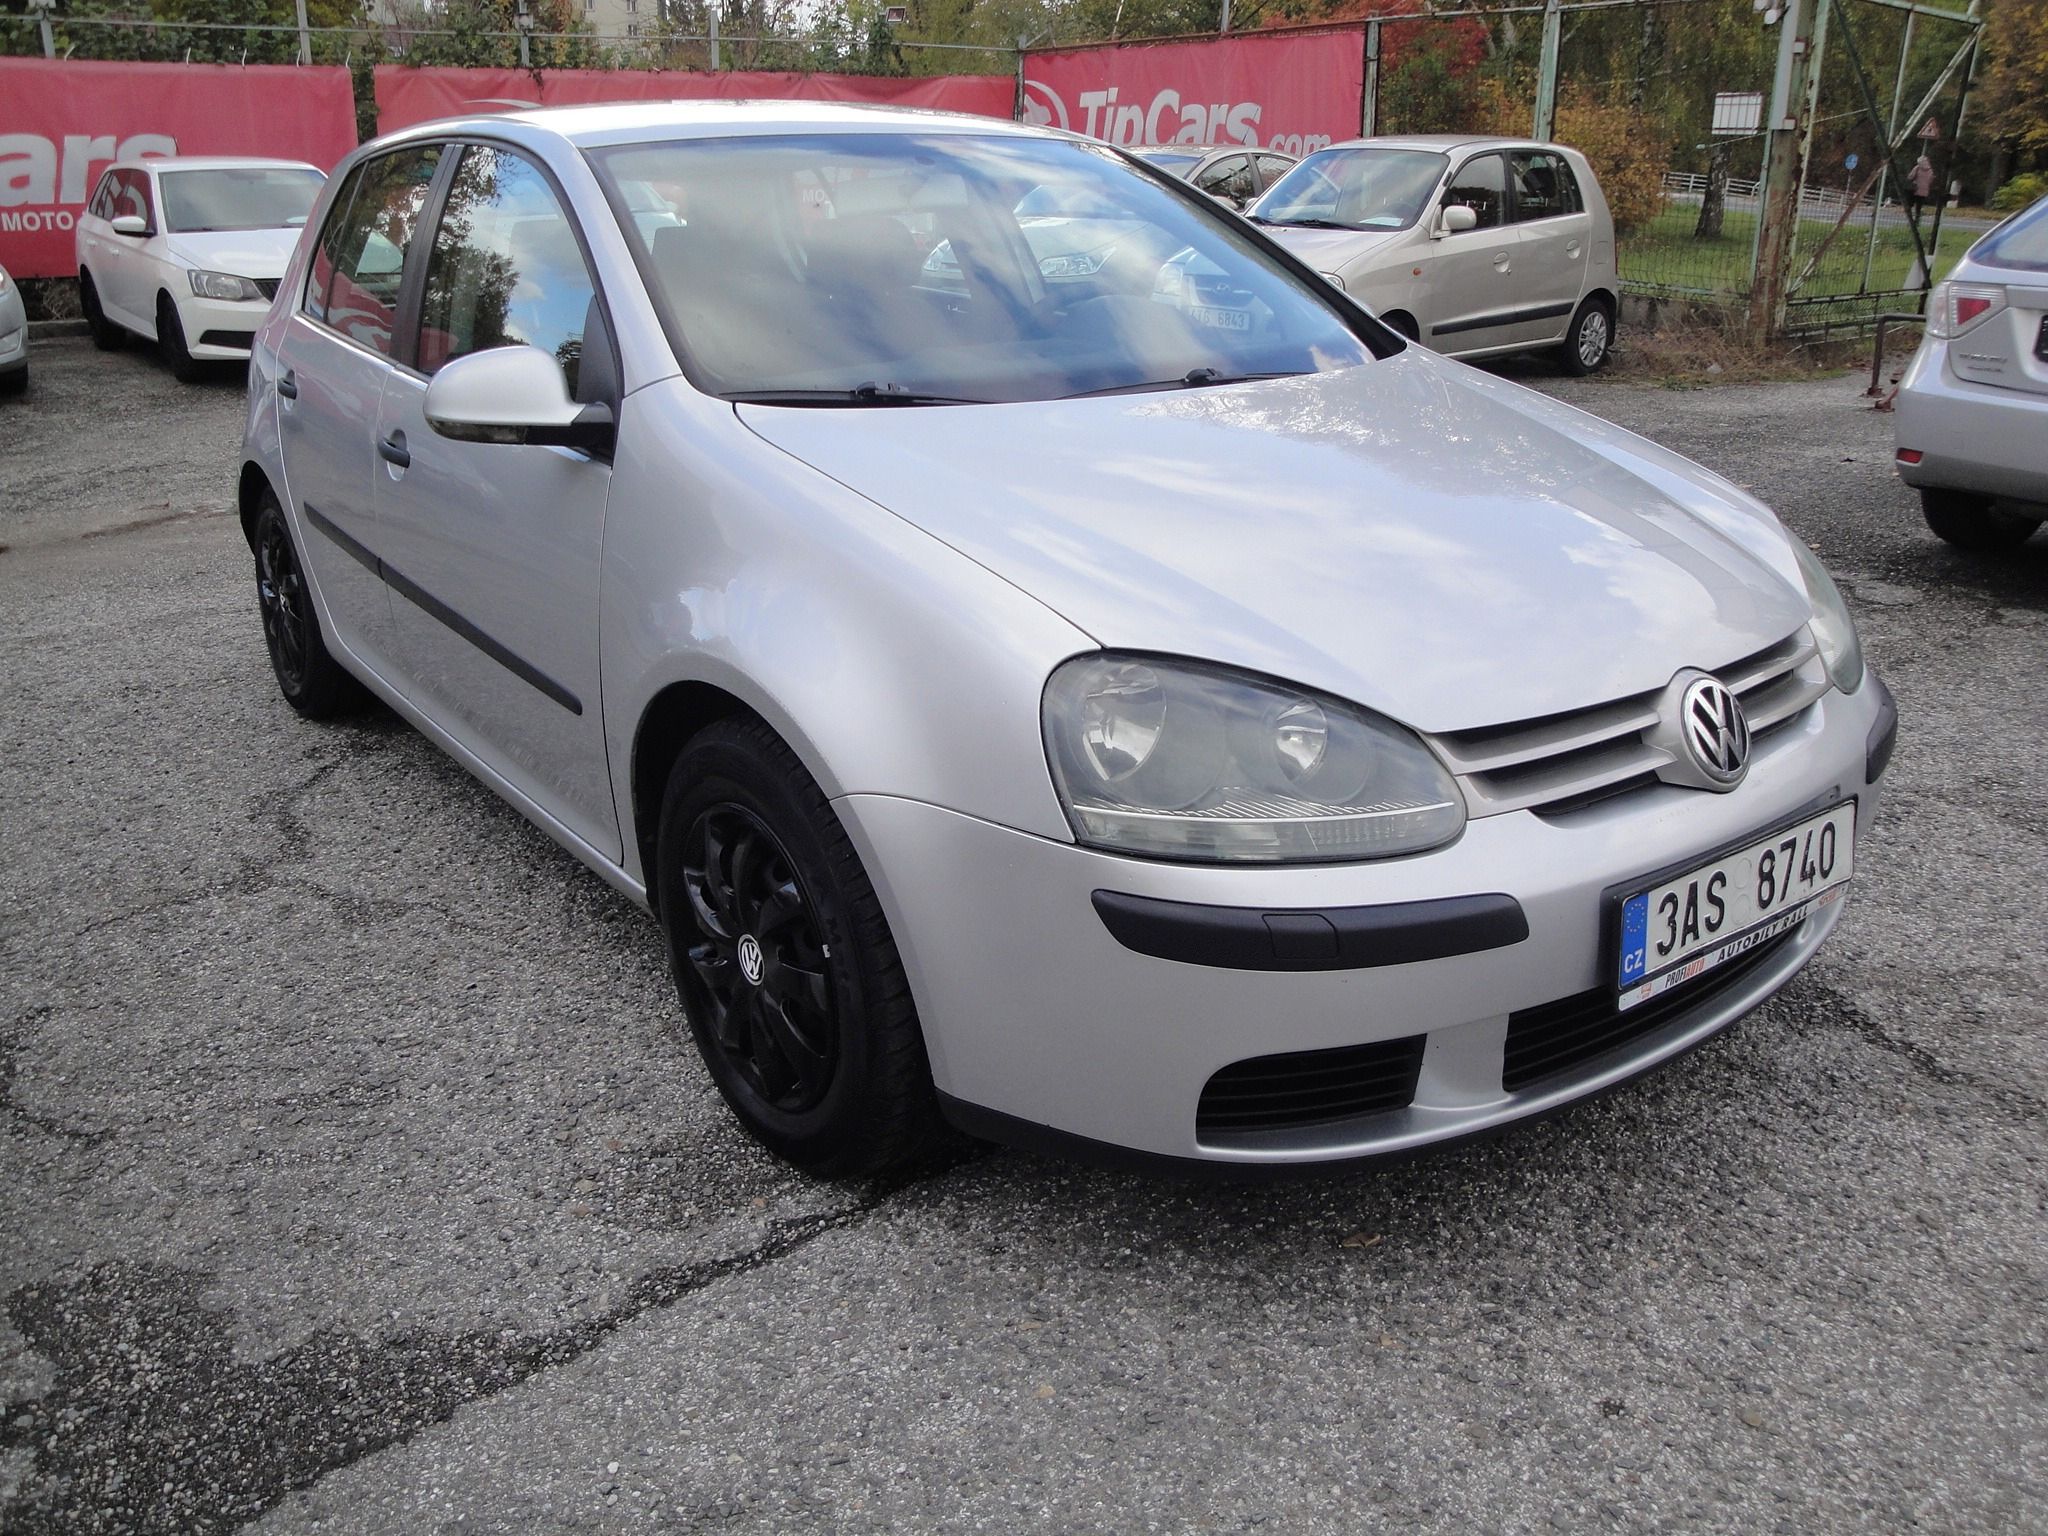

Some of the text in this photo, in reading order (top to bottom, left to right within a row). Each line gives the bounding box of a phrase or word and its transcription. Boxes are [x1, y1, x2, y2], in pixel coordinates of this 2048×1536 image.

[2, 211, 74, 232] MOTO
[1656, 820, 1836, 957] 3AS 8740
[1624, 948, 1643, 974] CZ
